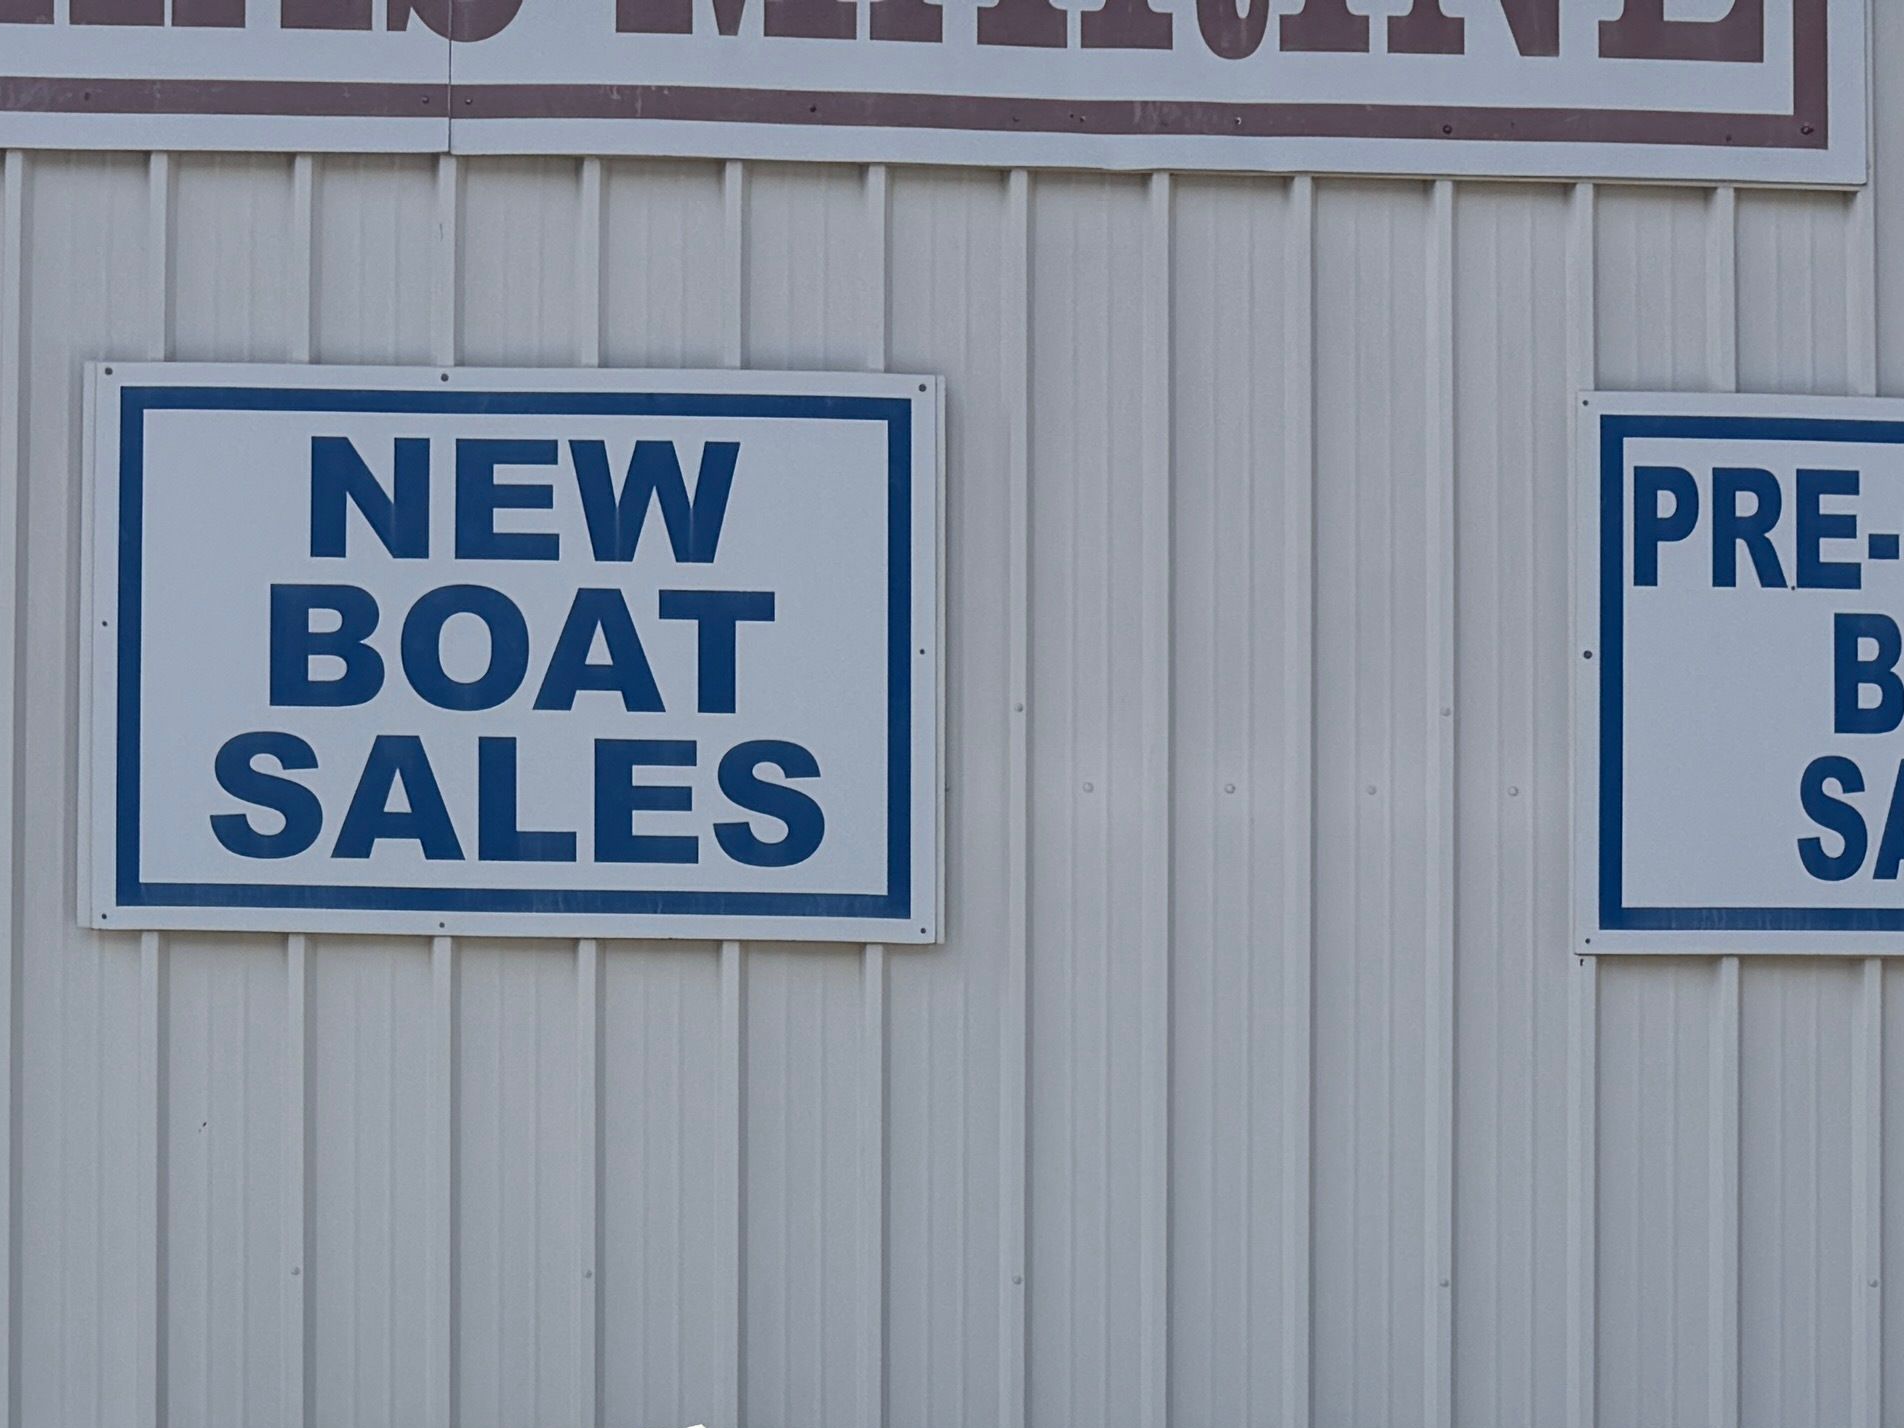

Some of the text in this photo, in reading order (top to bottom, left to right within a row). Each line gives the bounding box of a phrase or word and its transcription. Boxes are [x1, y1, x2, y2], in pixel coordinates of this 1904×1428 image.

[309, 435, 741, 564] NEW
[269, 583, 776, 714] BOAT
[209, 730, 826, 868] SALES
